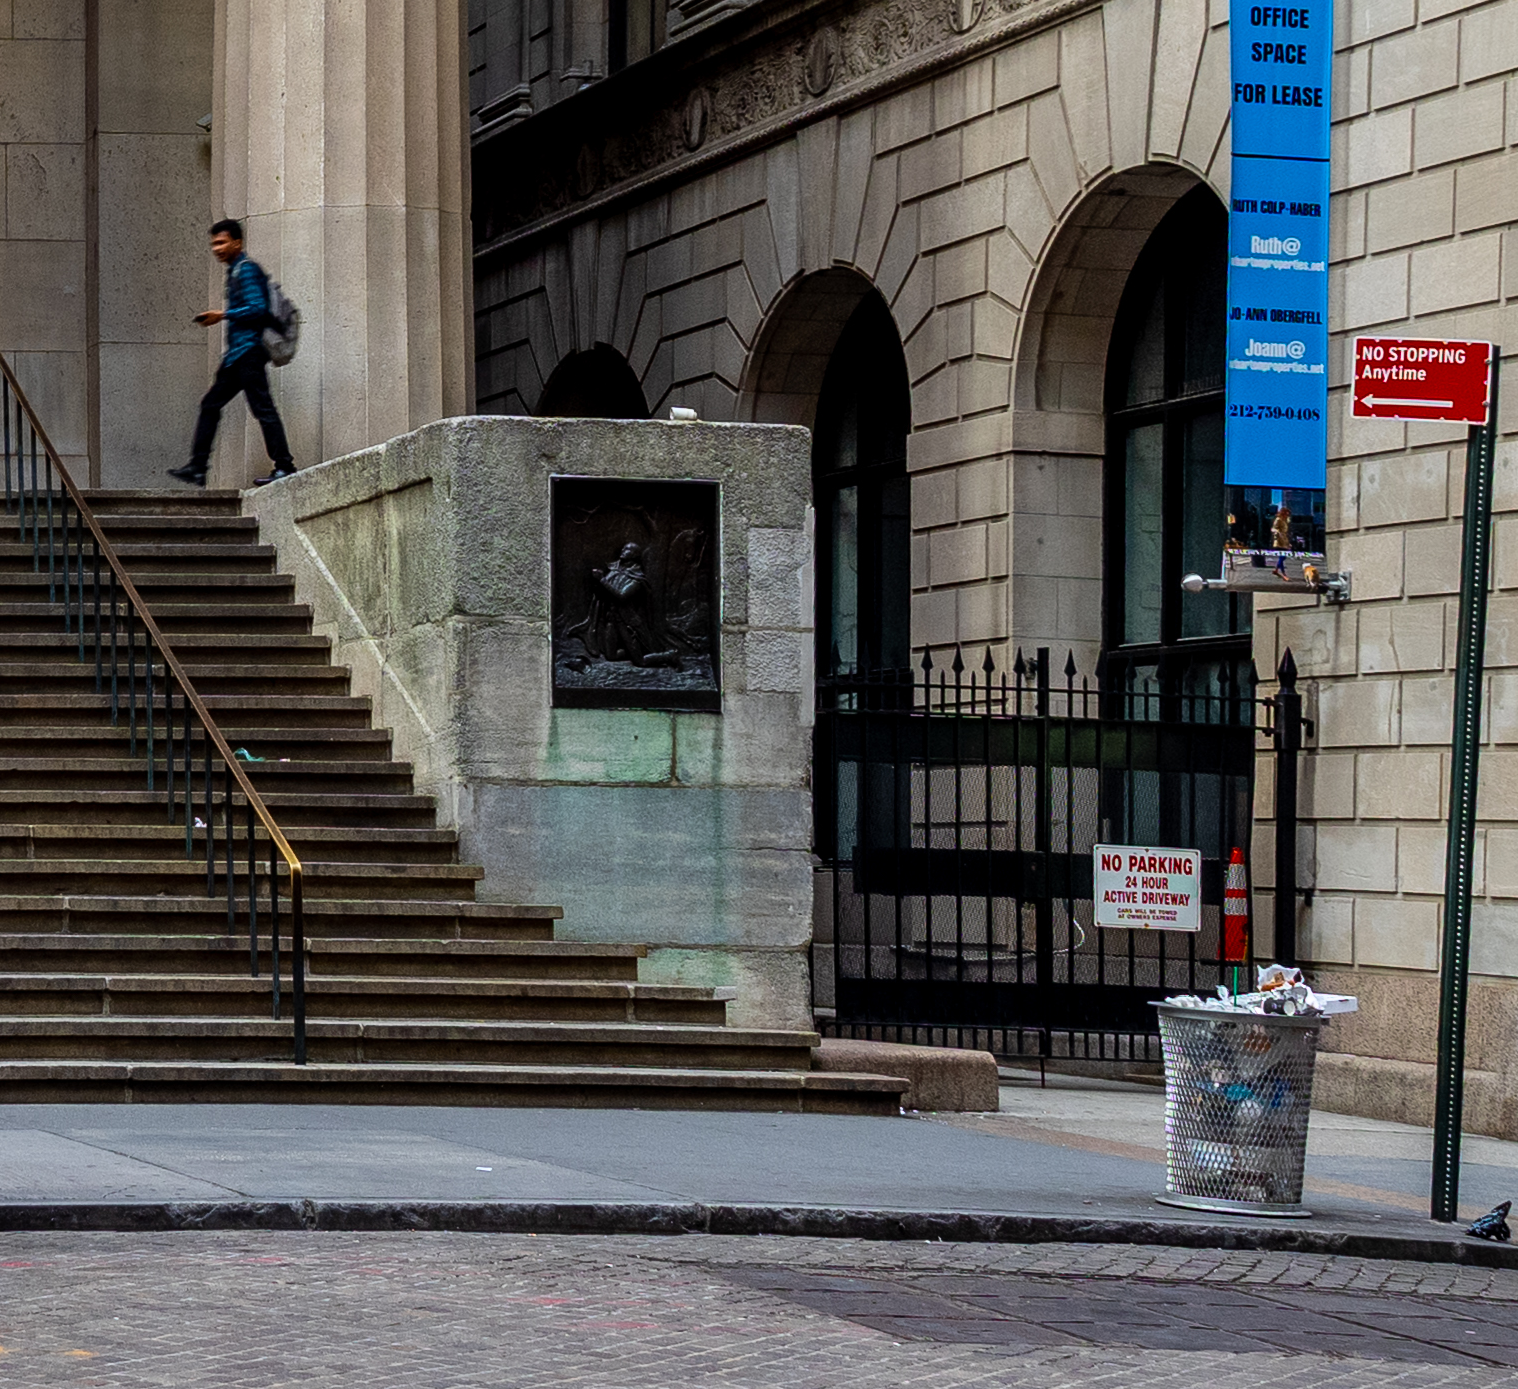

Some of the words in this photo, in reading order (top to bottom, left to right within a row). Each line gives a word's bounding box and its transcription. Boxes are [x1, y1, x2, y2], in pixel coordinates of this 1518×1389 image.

[1250, 6, 1310, 29] OFFICE
[1251, 42, 1307, 64] SPACE
[1234, 82, 1266, 104] FOR
[1272, 85, 1323, 107] LEASE
[1232, 199, 1258, 213] RUTH
[1250, 235, 1301, 256] Ruth@
[1229, 306, 1268, 322] JO-ANN
[1245, 338, 1306, 359] Joann@
[1362, 345, 1384, 361] NO
[1388, 346, 1466, 364] STOPPING
[1362, 364, 1427, 382] Anytime
[1101, 854, 1122, 872] NO
[1129, 855, 1193, 875] PARKING
[1125, 876, 1137, 888] 24
[1141, 876, 1168, 889] HOUR
[1103, 890, 1138, 904] ACTIVE
[1141, 892, 1190, 906] DRIVEWAY
